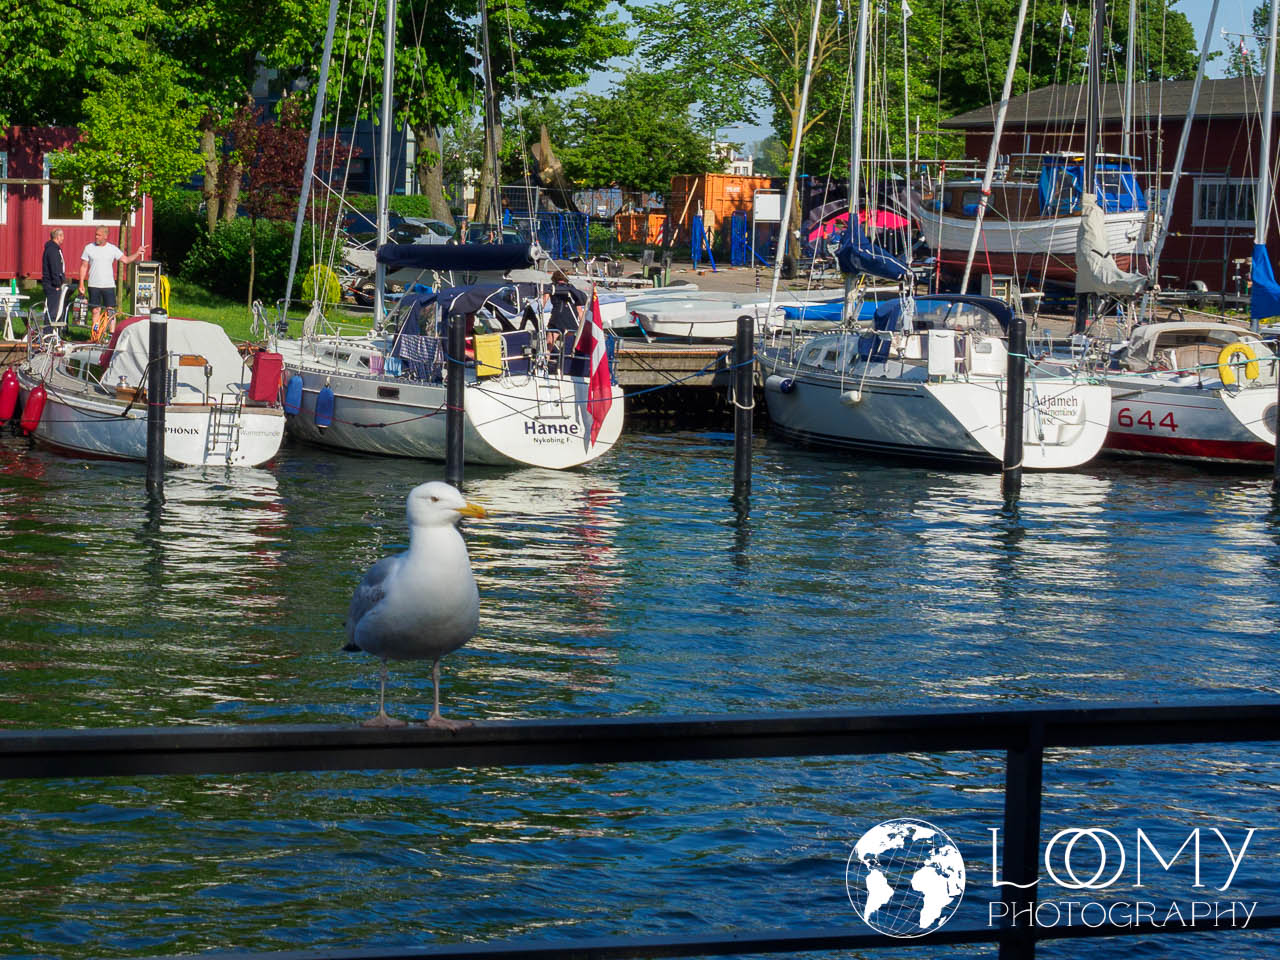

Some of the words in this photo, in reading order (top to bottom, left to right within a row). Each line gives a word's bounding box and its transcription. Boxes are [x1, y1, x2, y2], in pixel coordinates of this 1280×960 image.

[1036, 395, 1078, 409] Adjameh
[1117, 407, 1178, 432] 644
[524, 421, 578, 434] Hanne
